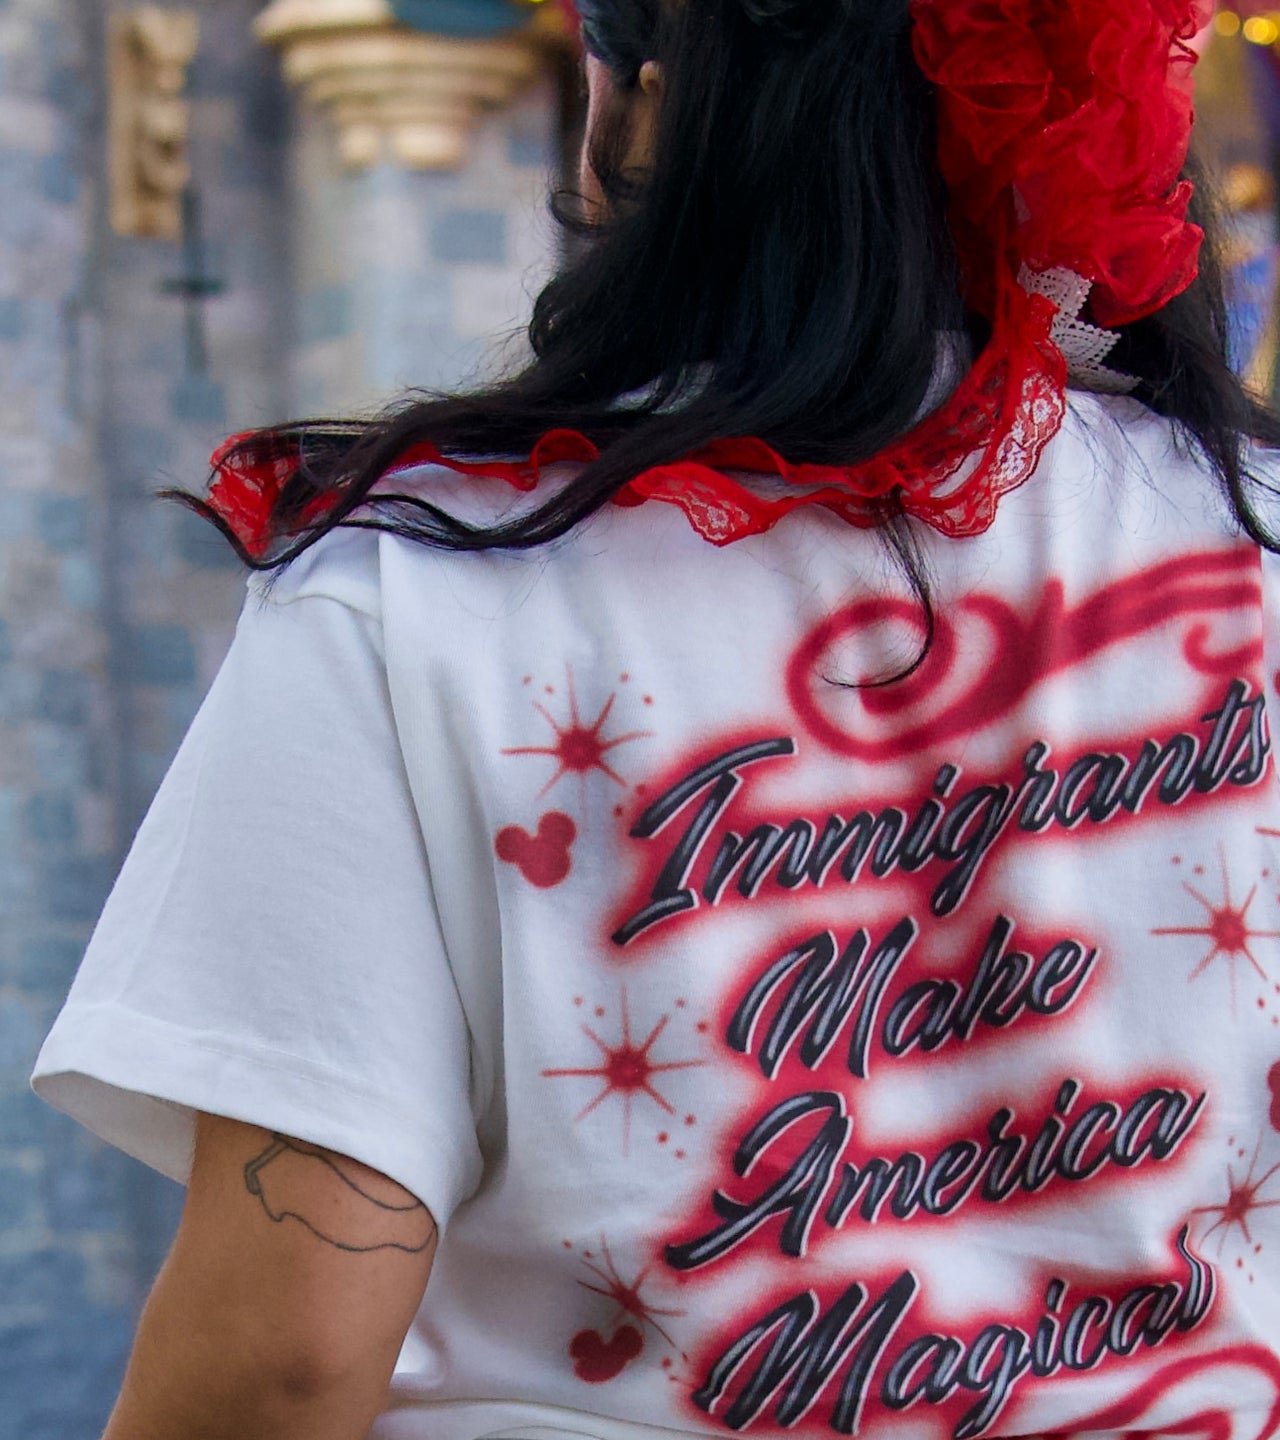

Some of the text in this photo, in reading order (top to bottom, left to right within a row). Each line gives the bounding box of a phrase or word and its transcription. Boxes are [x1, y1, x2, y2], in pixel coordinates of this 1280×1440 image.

[612, 678, 1271, 945] Immigrants
[726, 915, 1100, 1079] Make
[664, 1078, 1206, 1271] America
[693, 1222, 1216, 1440] Magical
